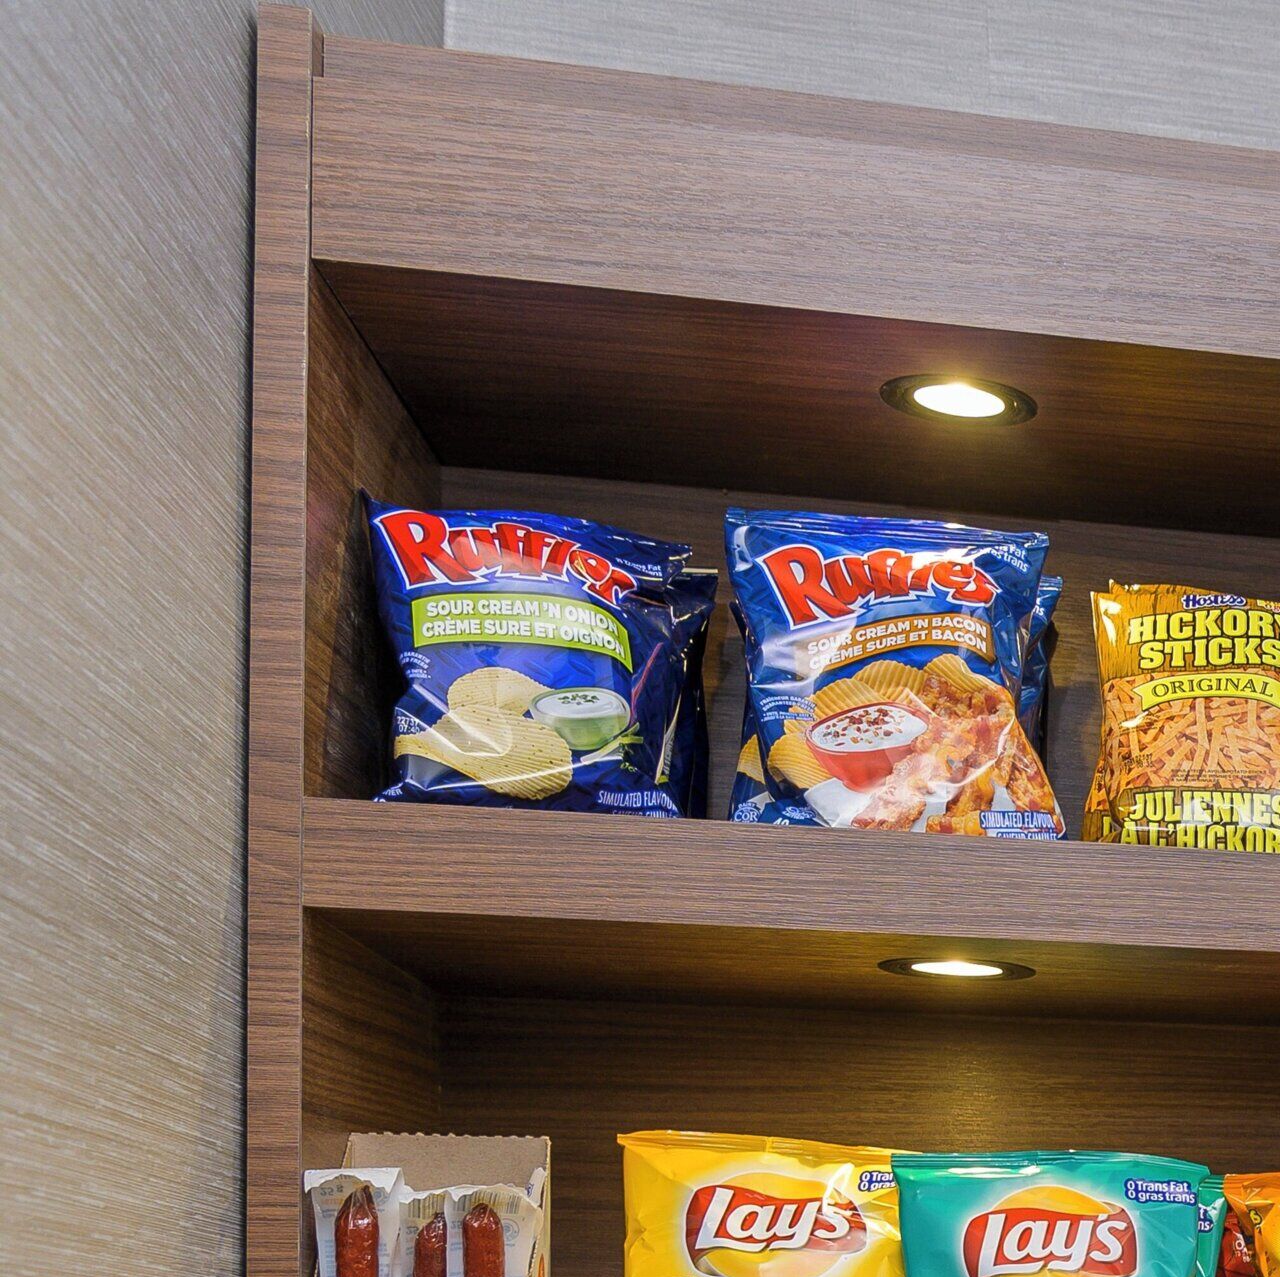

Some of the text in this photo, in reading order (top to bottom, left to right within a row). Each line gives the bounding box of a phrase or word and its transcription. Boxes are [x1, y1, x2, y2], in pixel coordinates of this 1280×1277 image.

[426, 600, 618, 636] SOUR CREAM 'N ONION
[422, 617, 625, 659] CRÈME SURE ET OIGNON
[807, 616, 987, 655] SOUR CREAM 'N BACON
[866, 629, 987, 654] SURE ET BACON
[1151, 677, 1274, 698] ORIGINAL
[1127, 1181, 1189, 1193] 0 Trans Fat
[1128, 1190, 1195, 1204] 0 gras trans
[695, 1187, 851, 1252] Lay's
